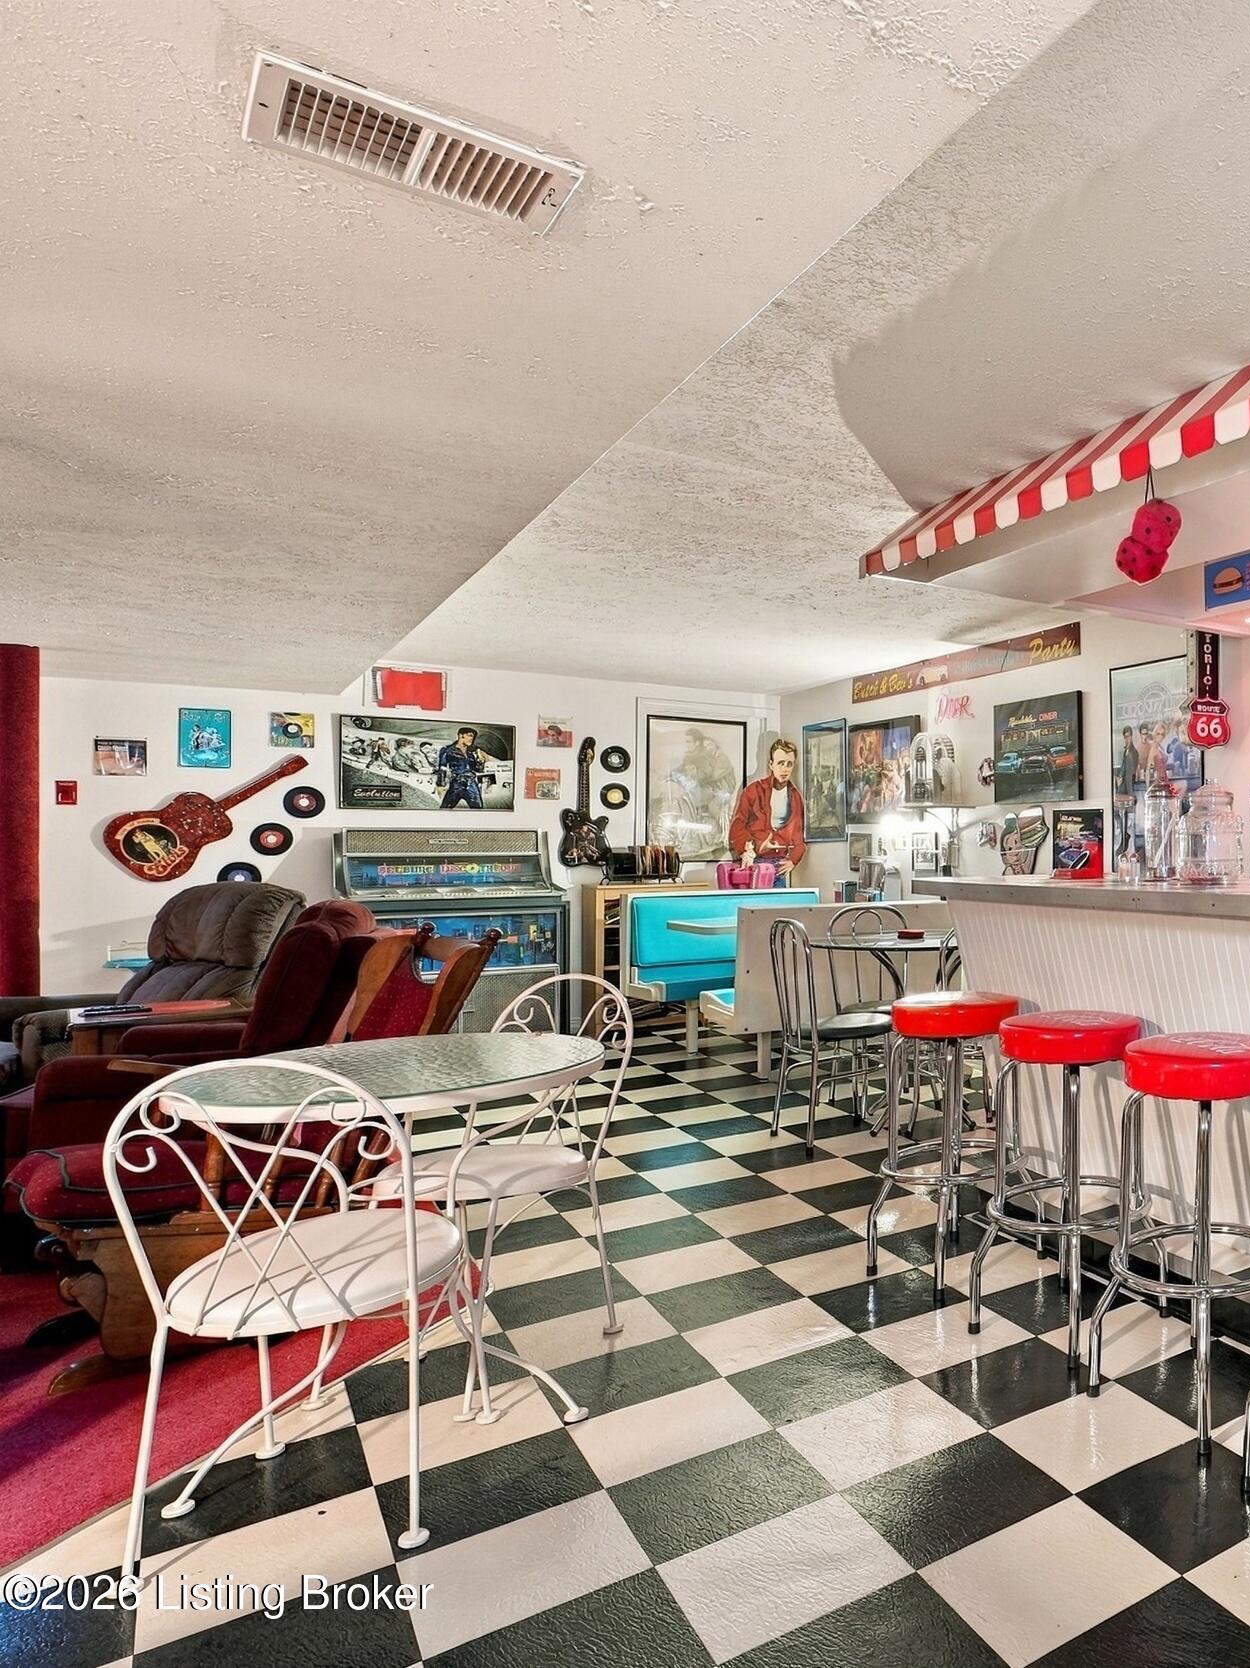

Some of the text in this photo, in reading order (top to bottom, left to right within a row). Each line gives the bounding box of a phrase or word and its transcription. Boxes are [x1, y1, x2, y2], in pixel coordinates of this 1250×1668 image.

[1029, 636, 1077, 664] Party
[1197, 704, 1221, 713] ROUTE
[1196, 717, 1223, 738] 66
[353, 788, 401, 798] Evolution
